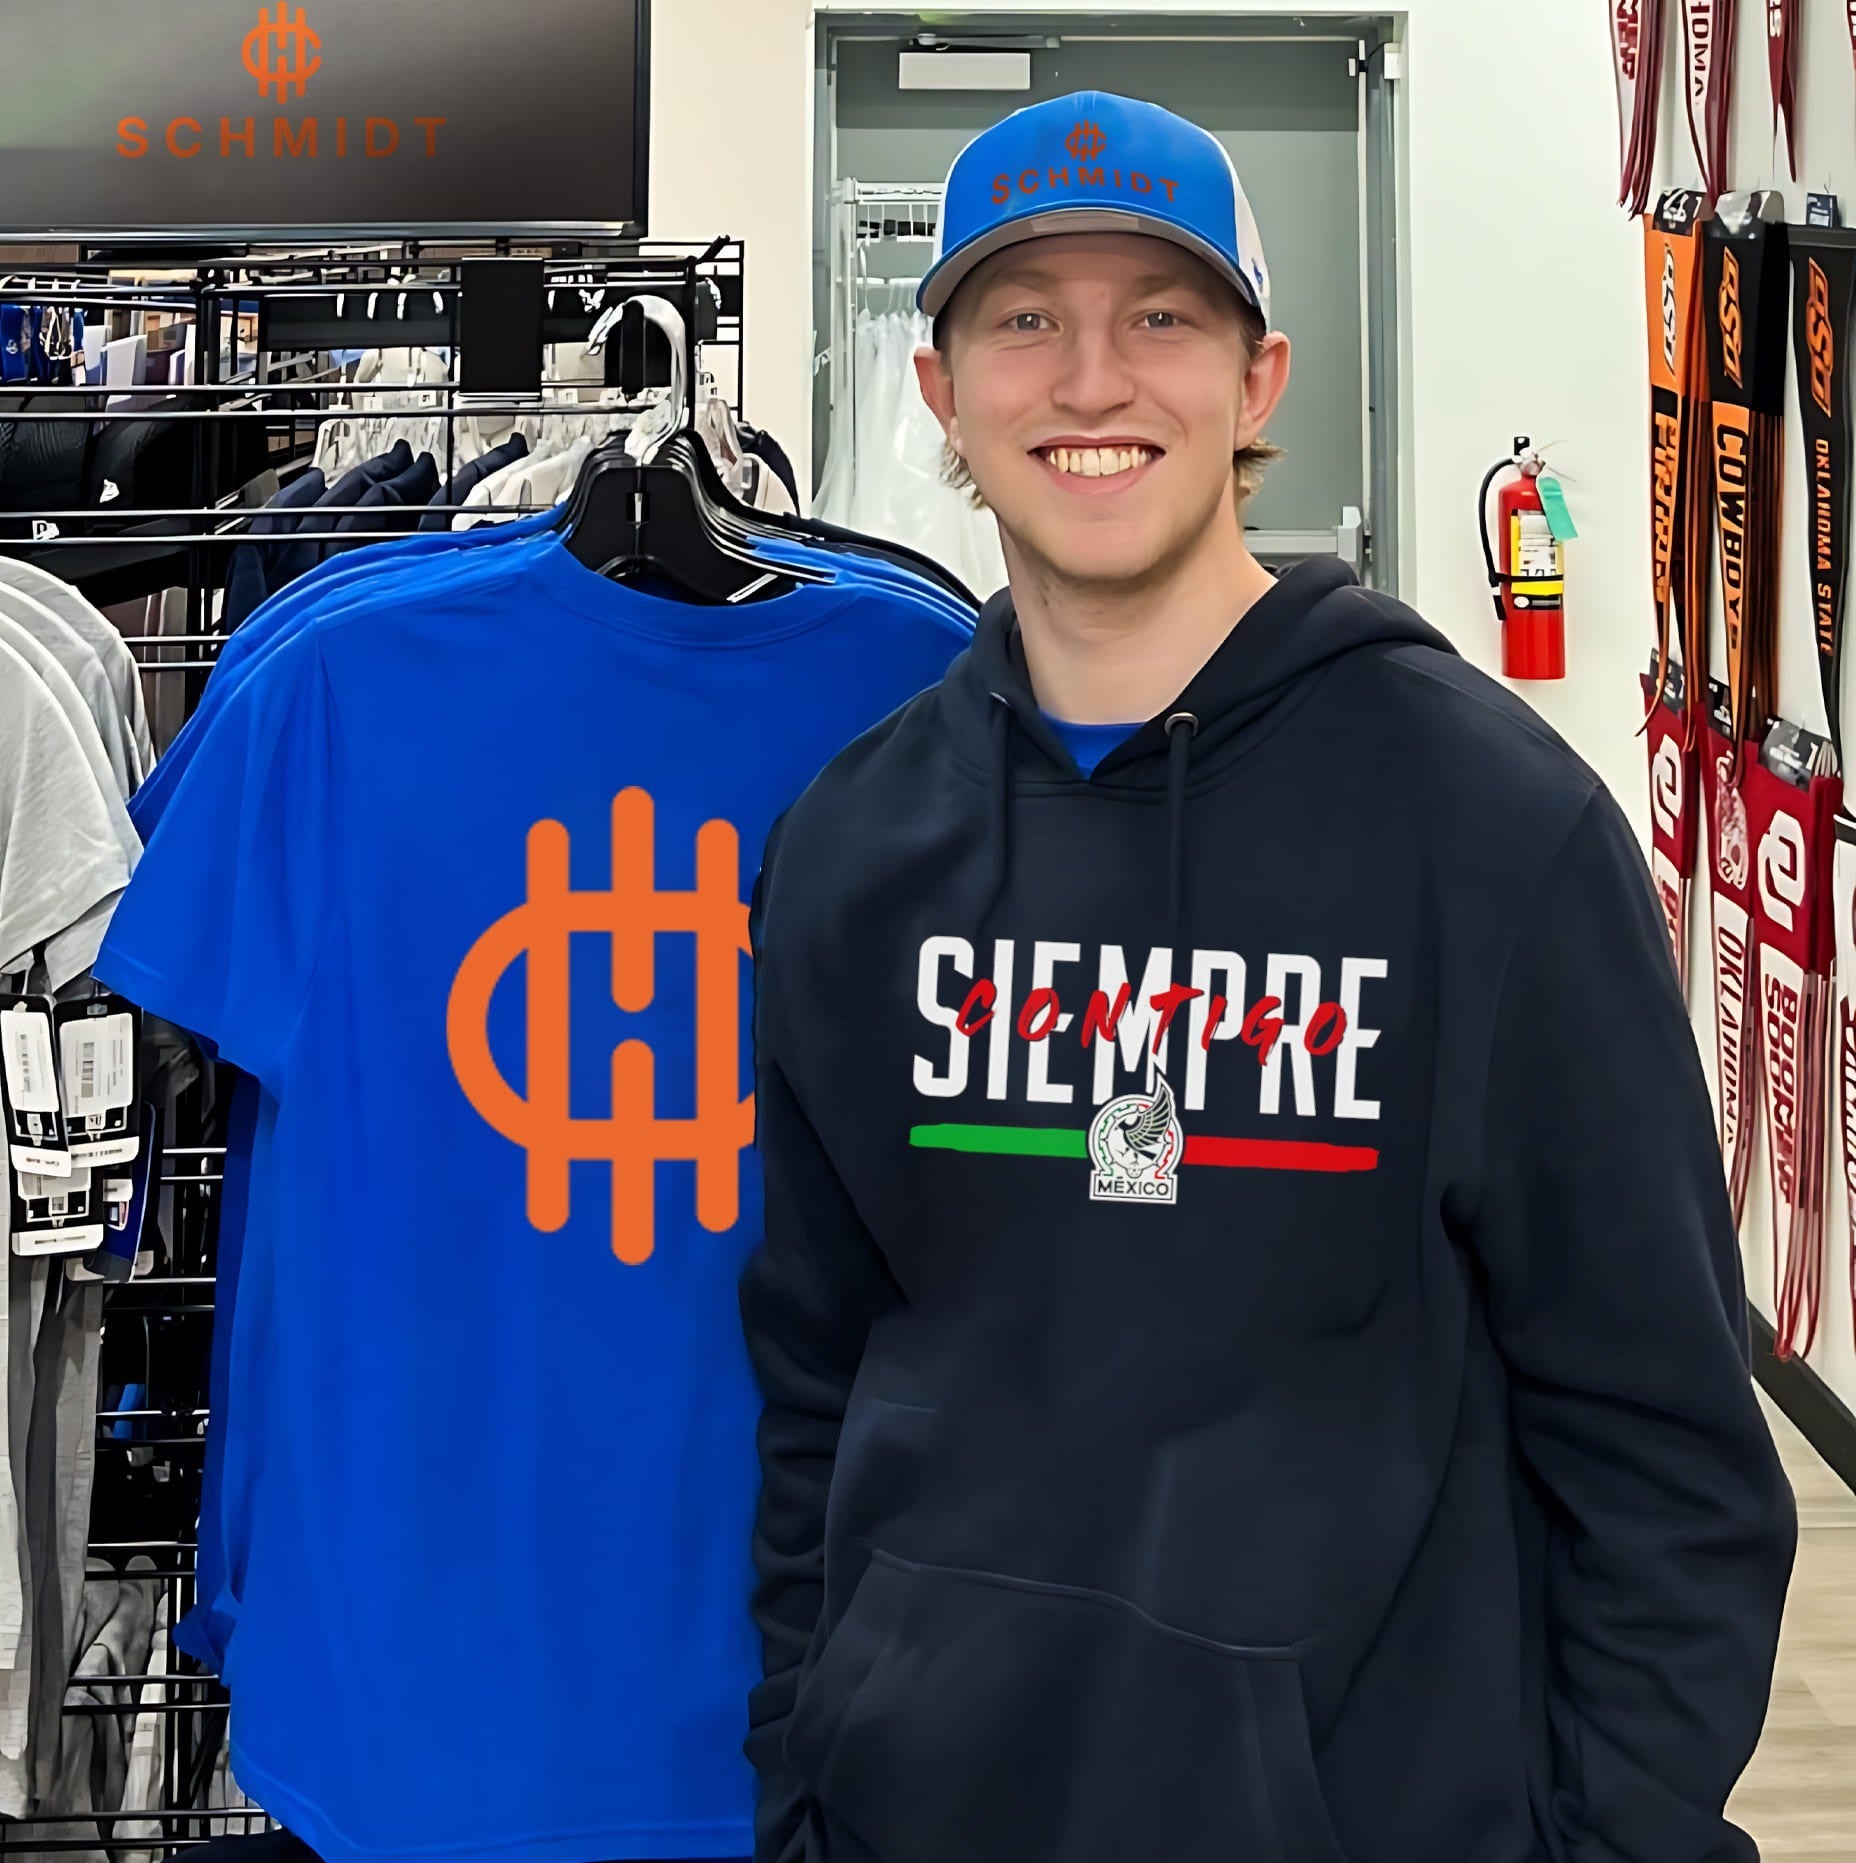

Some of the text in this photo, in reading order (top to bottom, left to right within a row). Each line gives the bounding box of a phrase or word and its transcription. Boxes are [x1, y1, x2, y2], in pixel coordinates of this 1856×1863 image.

[116, 117, 447, 158] SCHMIDT
[992, 167, 1179, 204] SCHMIDT
[913, 936, 1388, 1119] SIEMPRE
[956, 979, 1347, 1066] CONTIGO
